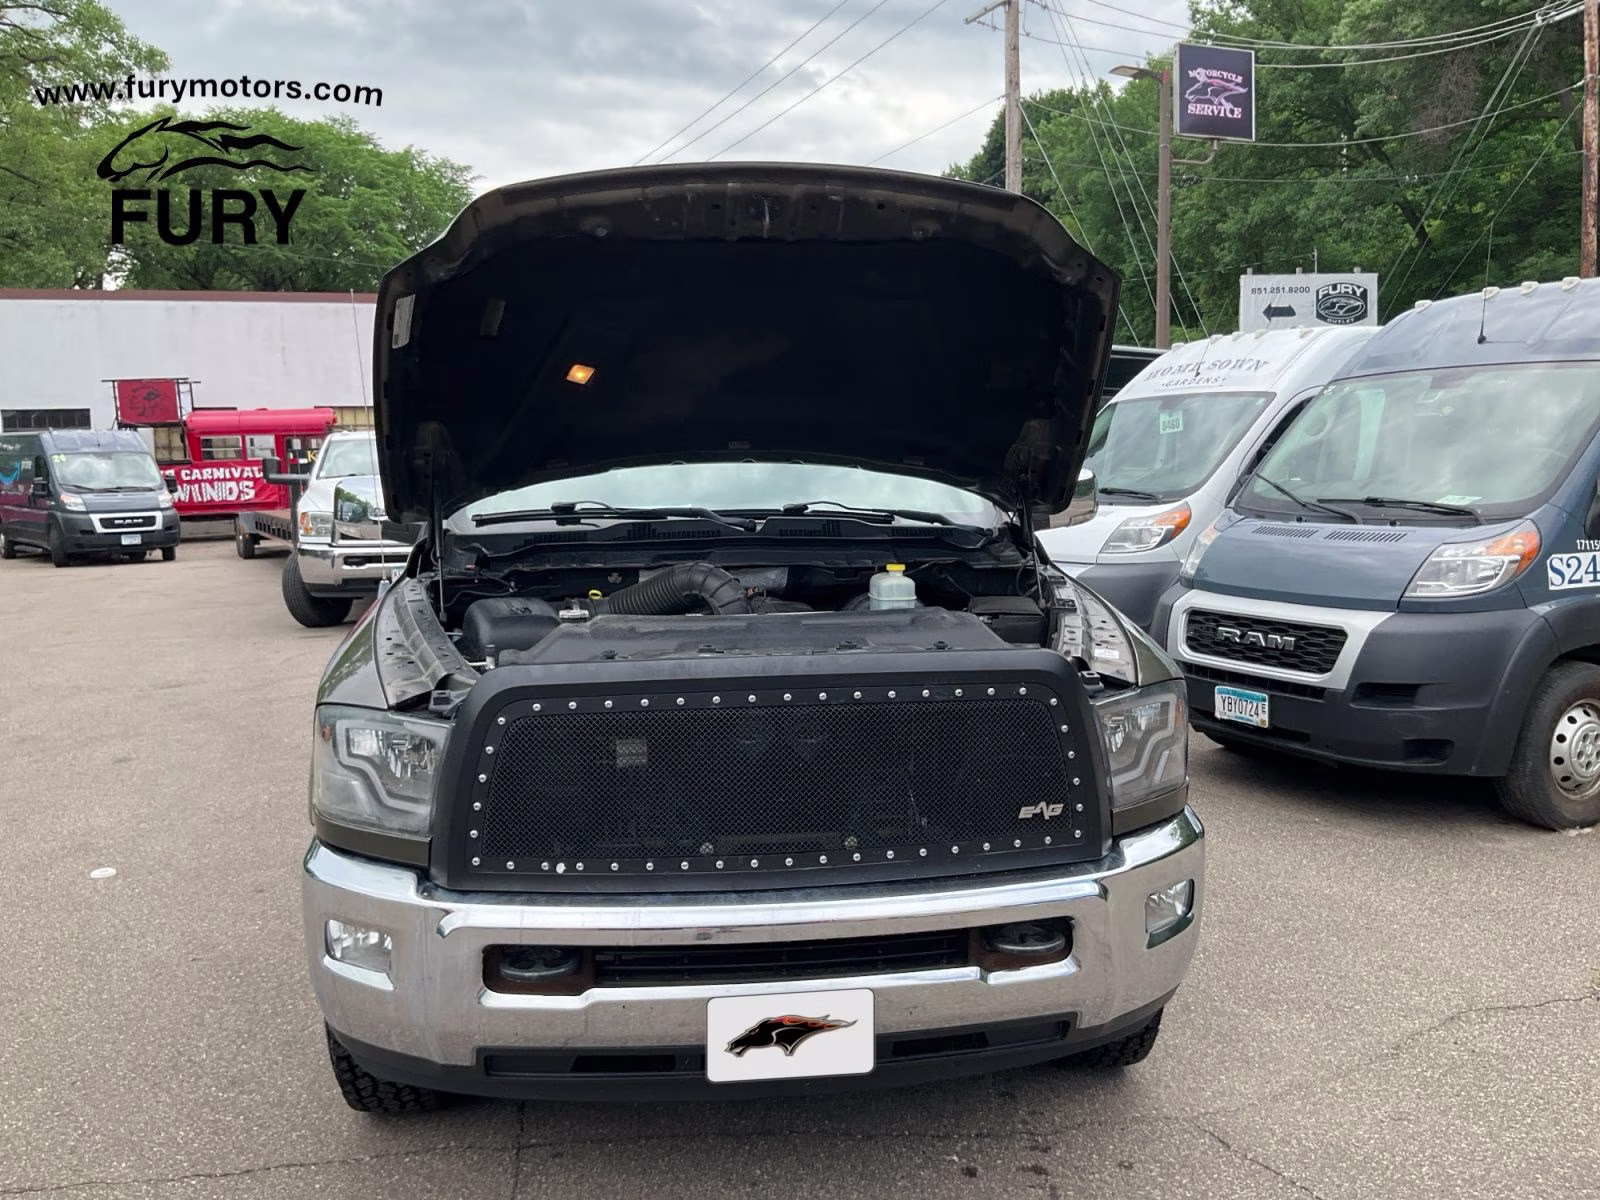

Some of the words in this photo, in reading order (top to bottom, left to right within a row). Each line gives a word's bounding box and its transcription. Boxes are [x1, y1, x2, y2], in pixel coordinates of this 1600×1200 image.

[1187, 102, 1241, 118] SERVICE
[1251, 286, 1310, 294] 651.251.8200
[1318, 284, 1364, 299] FURY
[181, 467, 263, 480] CARNIVAL
[172, 481, 255, 503] WINDS
[1217, 627, 1295, 651] RAM
